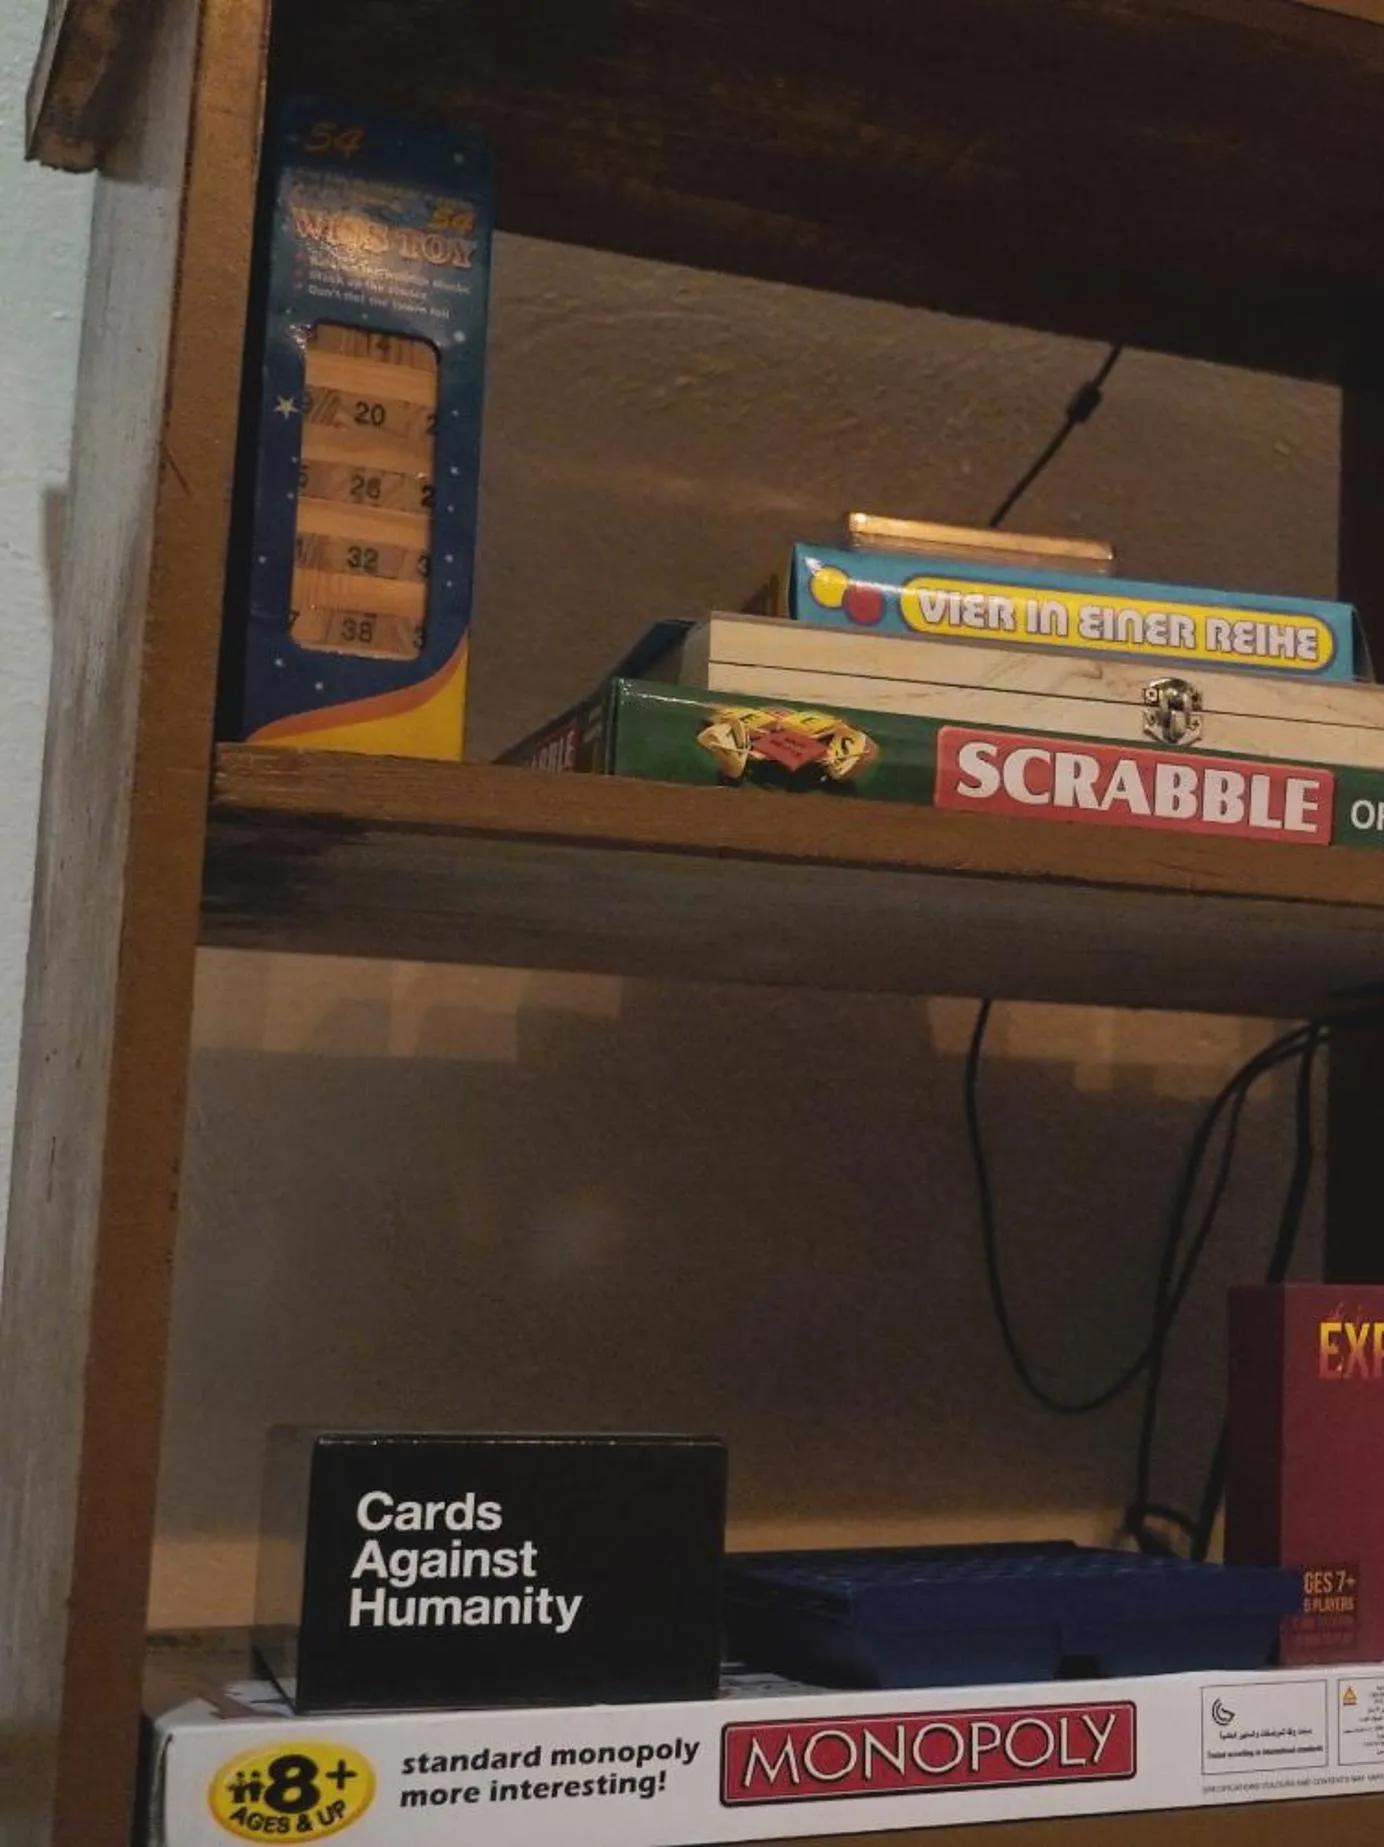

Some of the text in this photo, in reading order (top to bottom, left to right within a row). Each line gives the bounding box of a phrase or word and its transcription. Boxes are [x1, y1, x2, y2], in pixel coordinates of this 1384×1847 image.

[304, 122, 364, 157] 54
[354, 401, 385, 426] 20
[349, 474, 381, 499] 26
[347, 546, 379, 573] 32
[341, 618, 373, 643] 38
[917, 588, 1318, 660] VIER IN EINER REIHE
[956, 741, 1320, 833] SCRABBLE
[356, 1490, 503, 1531] Cards
[350, 1538, 538, 1588] Against
[1303, 1570, 1357, 1594] GES 7+
[349, 1586, 584, 1634] Humanity
[1313, 1596, 1355, 1612] PLAYERS
[401, 1737, 701, 1776] standard monopoly
[744, 1713, 1117, 1788] MONOPOLY
[264, 1754, 358, 1814] 8+
[400, 1770, 667, 1808] more interesting!
[228, 1799, 346, 1833] AGES & UP
